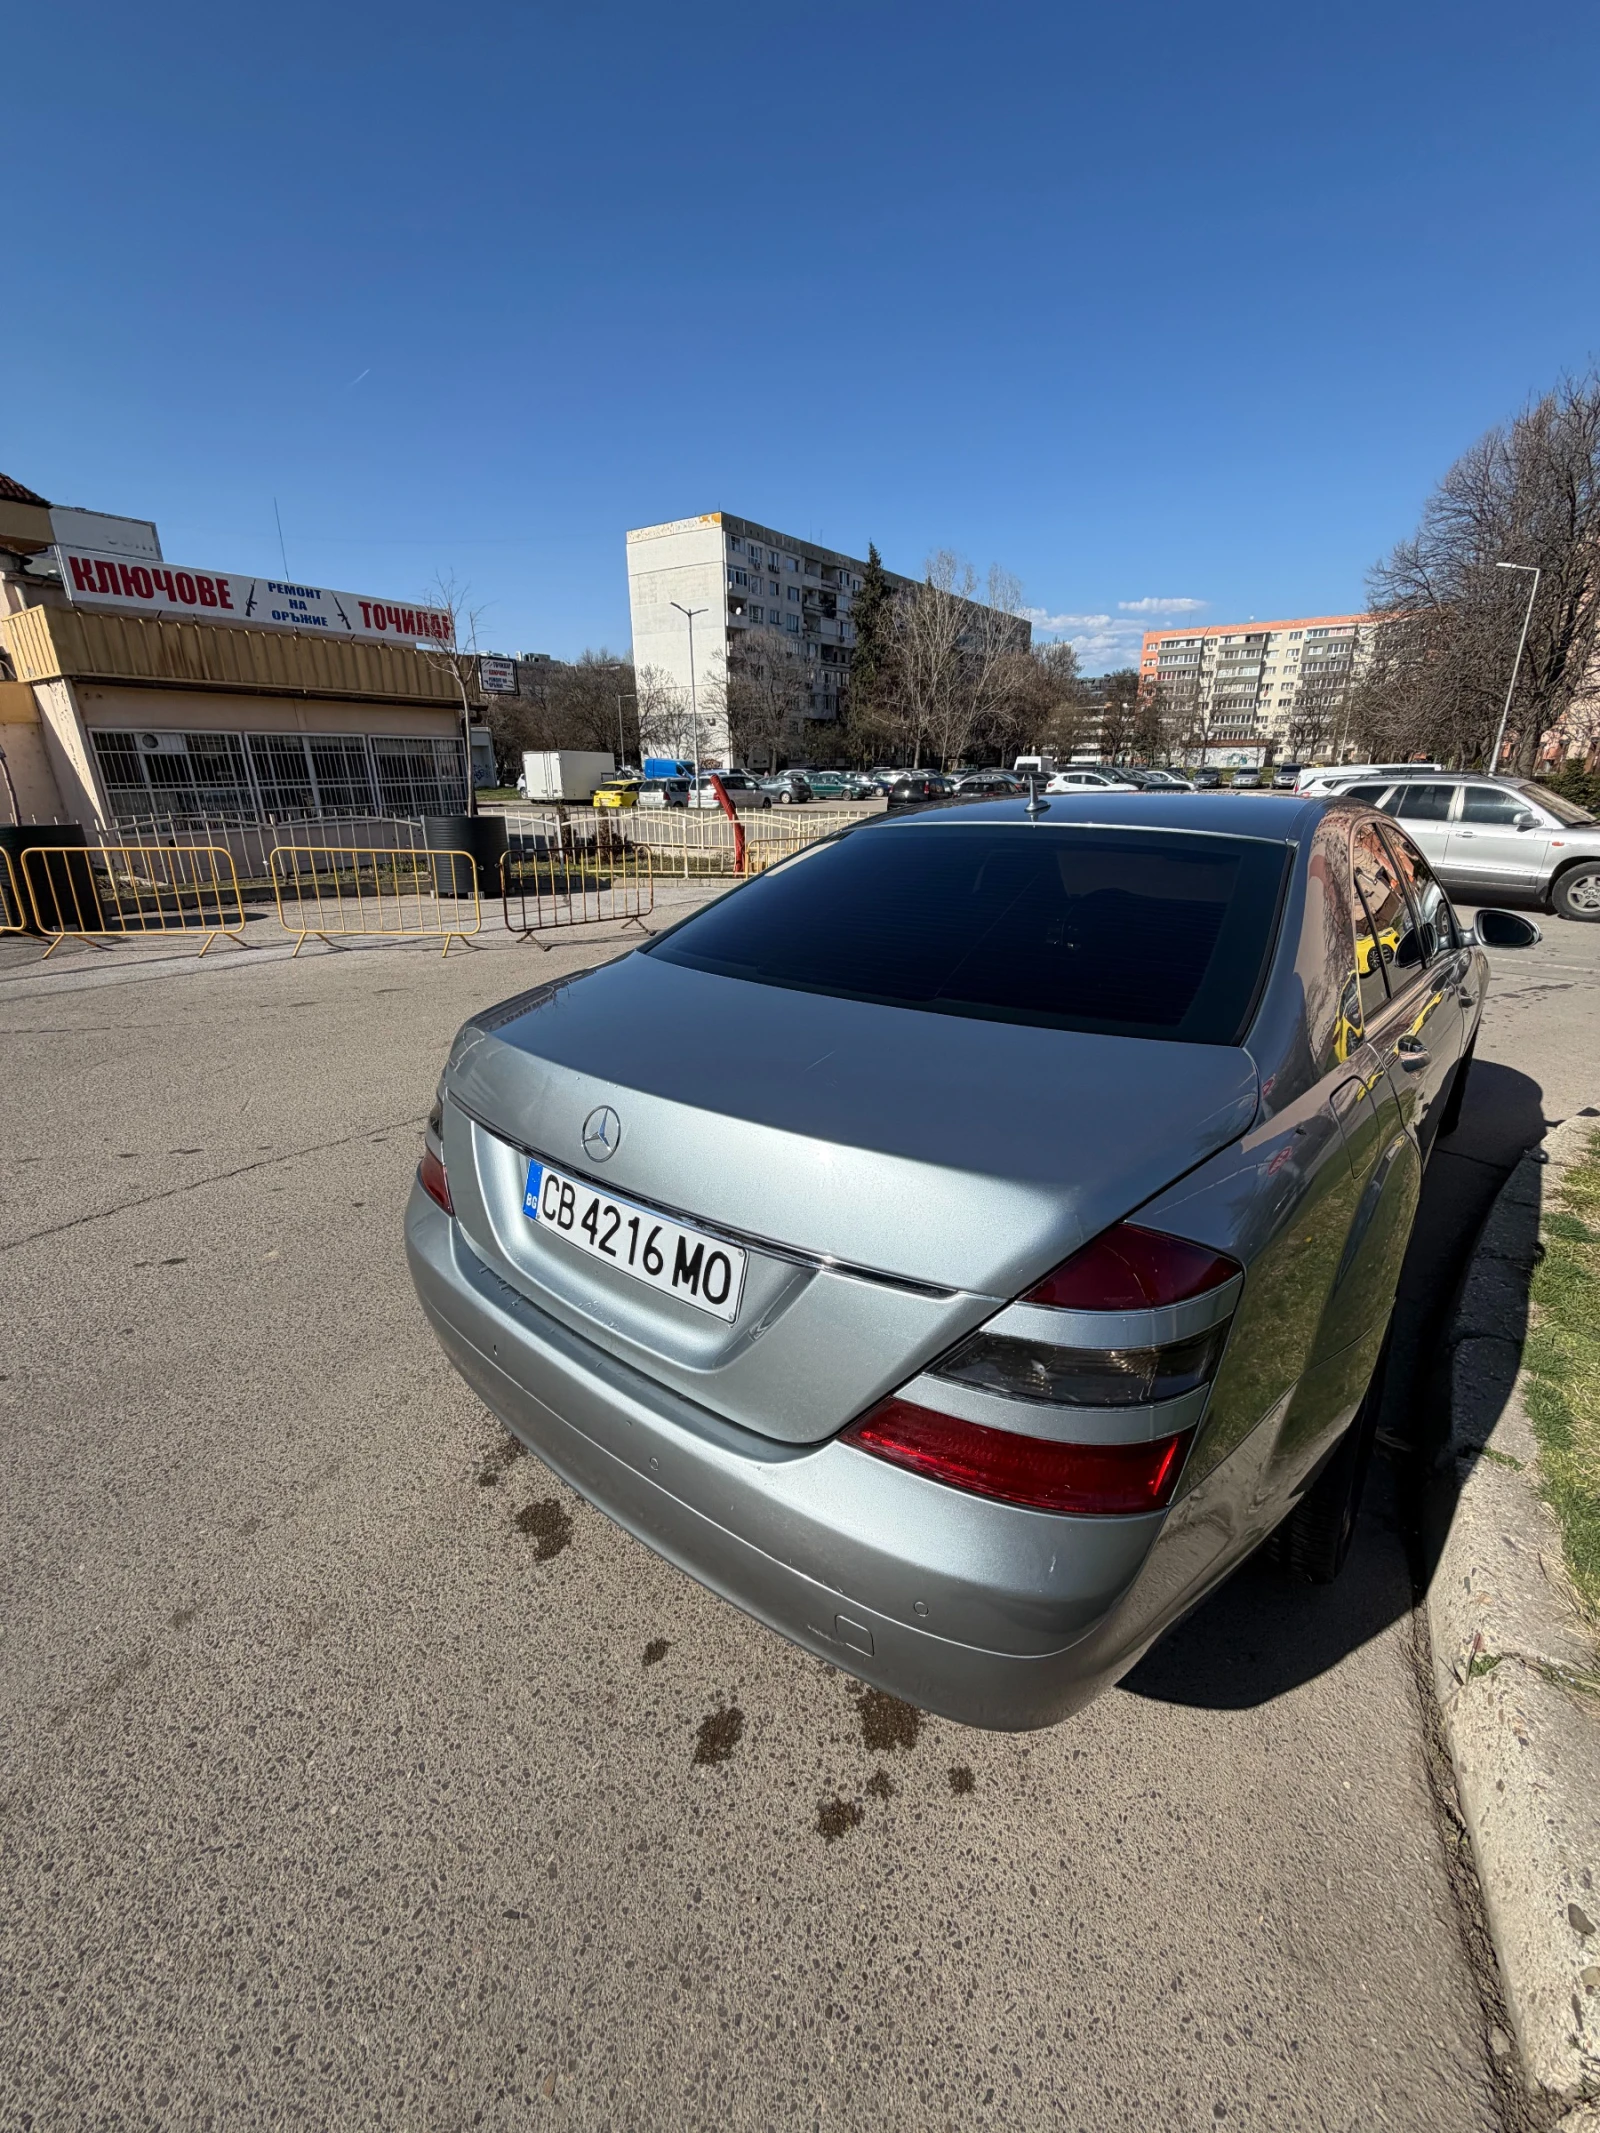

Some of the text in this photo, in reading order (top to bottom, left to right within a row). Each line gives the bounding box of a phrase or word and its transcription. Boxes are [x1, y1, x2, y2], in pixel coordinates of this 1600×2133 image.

[68, 556, 234, 609] КЛЮЧОВЕ
[268, 582, 321, 600] РЕМОНТ
[289, 599, 308, 611] НА
[271, 610, 328, 627] ОРЪЖИЕ
[526, 1192, 537, 1209] BG
[542, 1174, 731, 1305] CB 4216 MO
